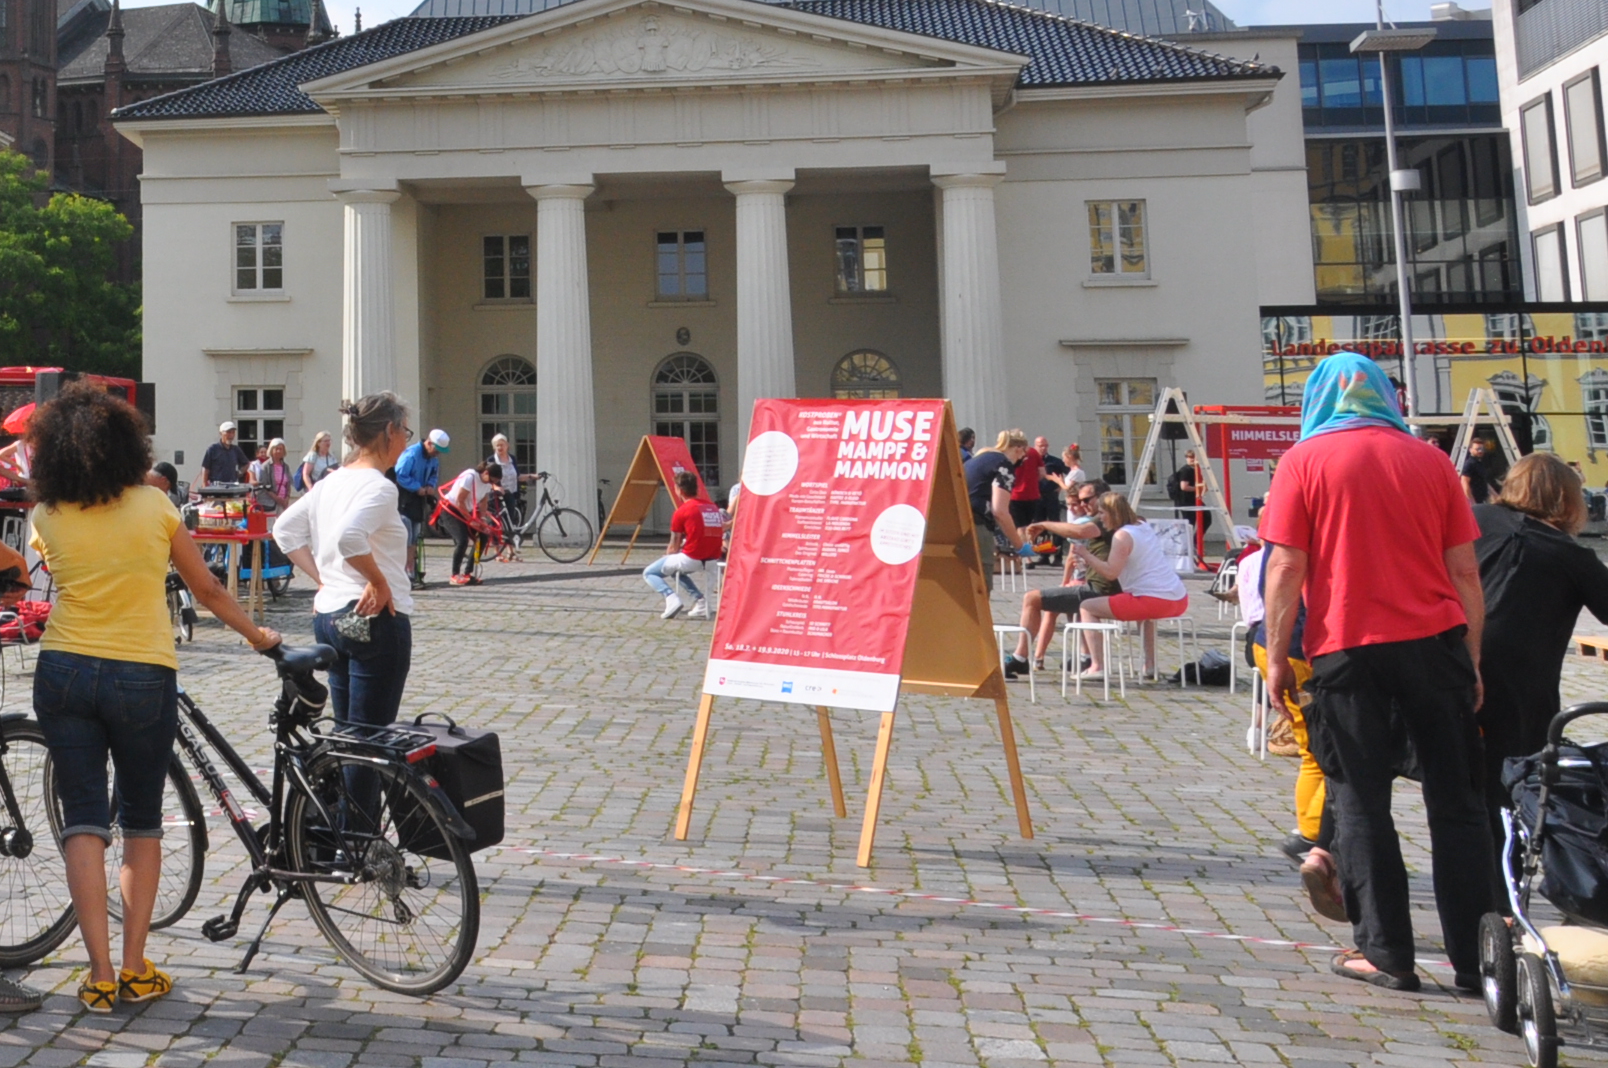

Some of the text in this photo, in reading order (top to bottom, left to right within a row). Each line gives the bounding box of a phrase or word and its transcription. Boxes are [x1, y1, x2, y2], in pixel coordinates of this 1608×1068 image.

[1490, 339, 1518, 353] zu
[842, 410, 934, 441] MUSE
[837, 441, 928, 461] MAMPF &
[833, 460, 927, 480] MAMMON
[857, 653, 885, 664] Oldenburg
